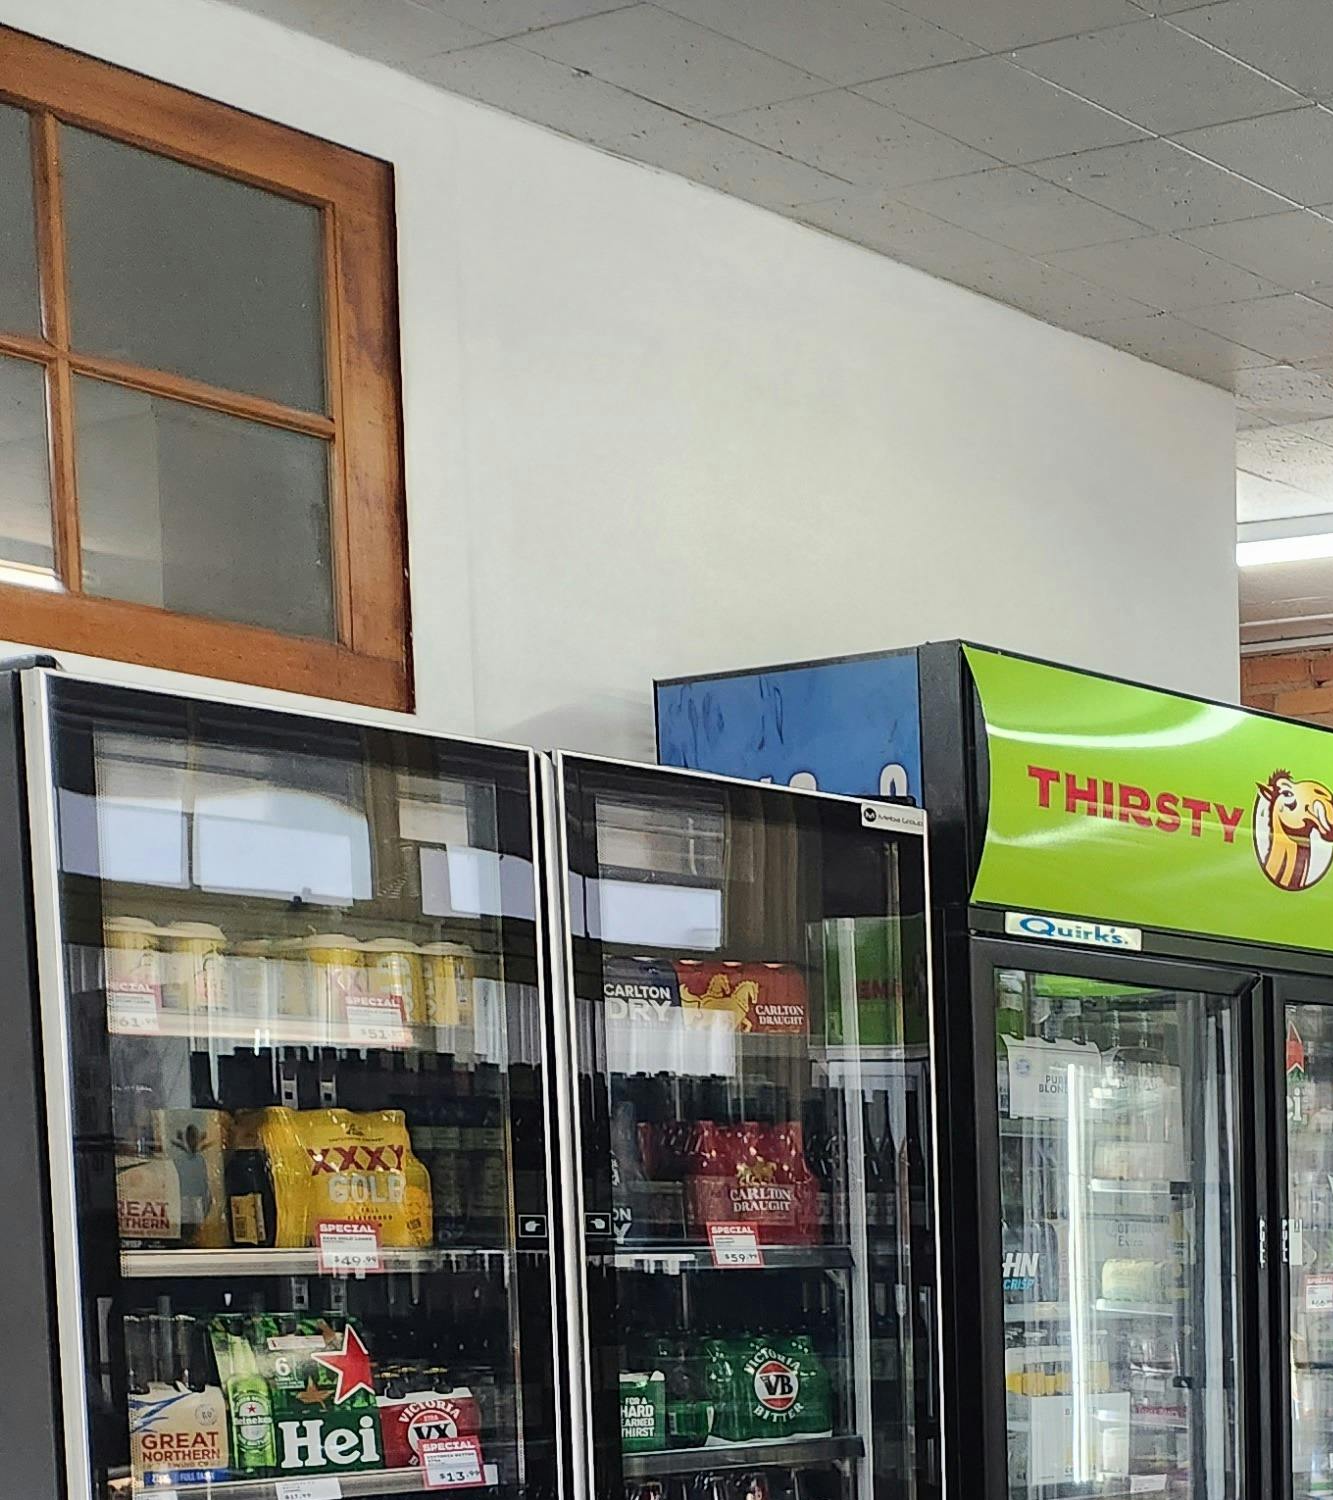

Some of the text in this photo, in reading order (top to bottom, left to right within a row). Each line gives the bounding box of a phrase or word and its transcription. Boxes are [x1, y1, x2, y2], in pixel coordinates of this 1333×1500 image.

[1028, 765, 1244, 843] THIRSTY
[605, 984, 671, 999] CARLTON
[605, 998, 673, 1022] DRY
[755, 1004, 804, 1017] CARLTON
[759, 1014, 804, 1026] DRAUGHT
[730, 1187, 792, 1202] CARLTON
[733, 1200, 791, 1213] DRAUGHT
[319, 1223, 376, 1233] SPECIAL
[711, 1226, 754, 1235] SPECIAL
[743, 1347, 802, 1375] VICTORIA
[761, 1375, 793, 1396] VB
[399, 1399, 460, 1423] VICTORIA
[620, 1404, 653, 1418] HARD
[752, 1402, 805, 1423] BITTER
[620, 1426, 655, 1438] THIRST
[141, 1432, 219, 1450] GREAT
[279, 1416, 380, 1468] Hei
[422, 1440, 476, 1451] SPECIAL
[142, 1449, 220, 1462] NORTHERN
